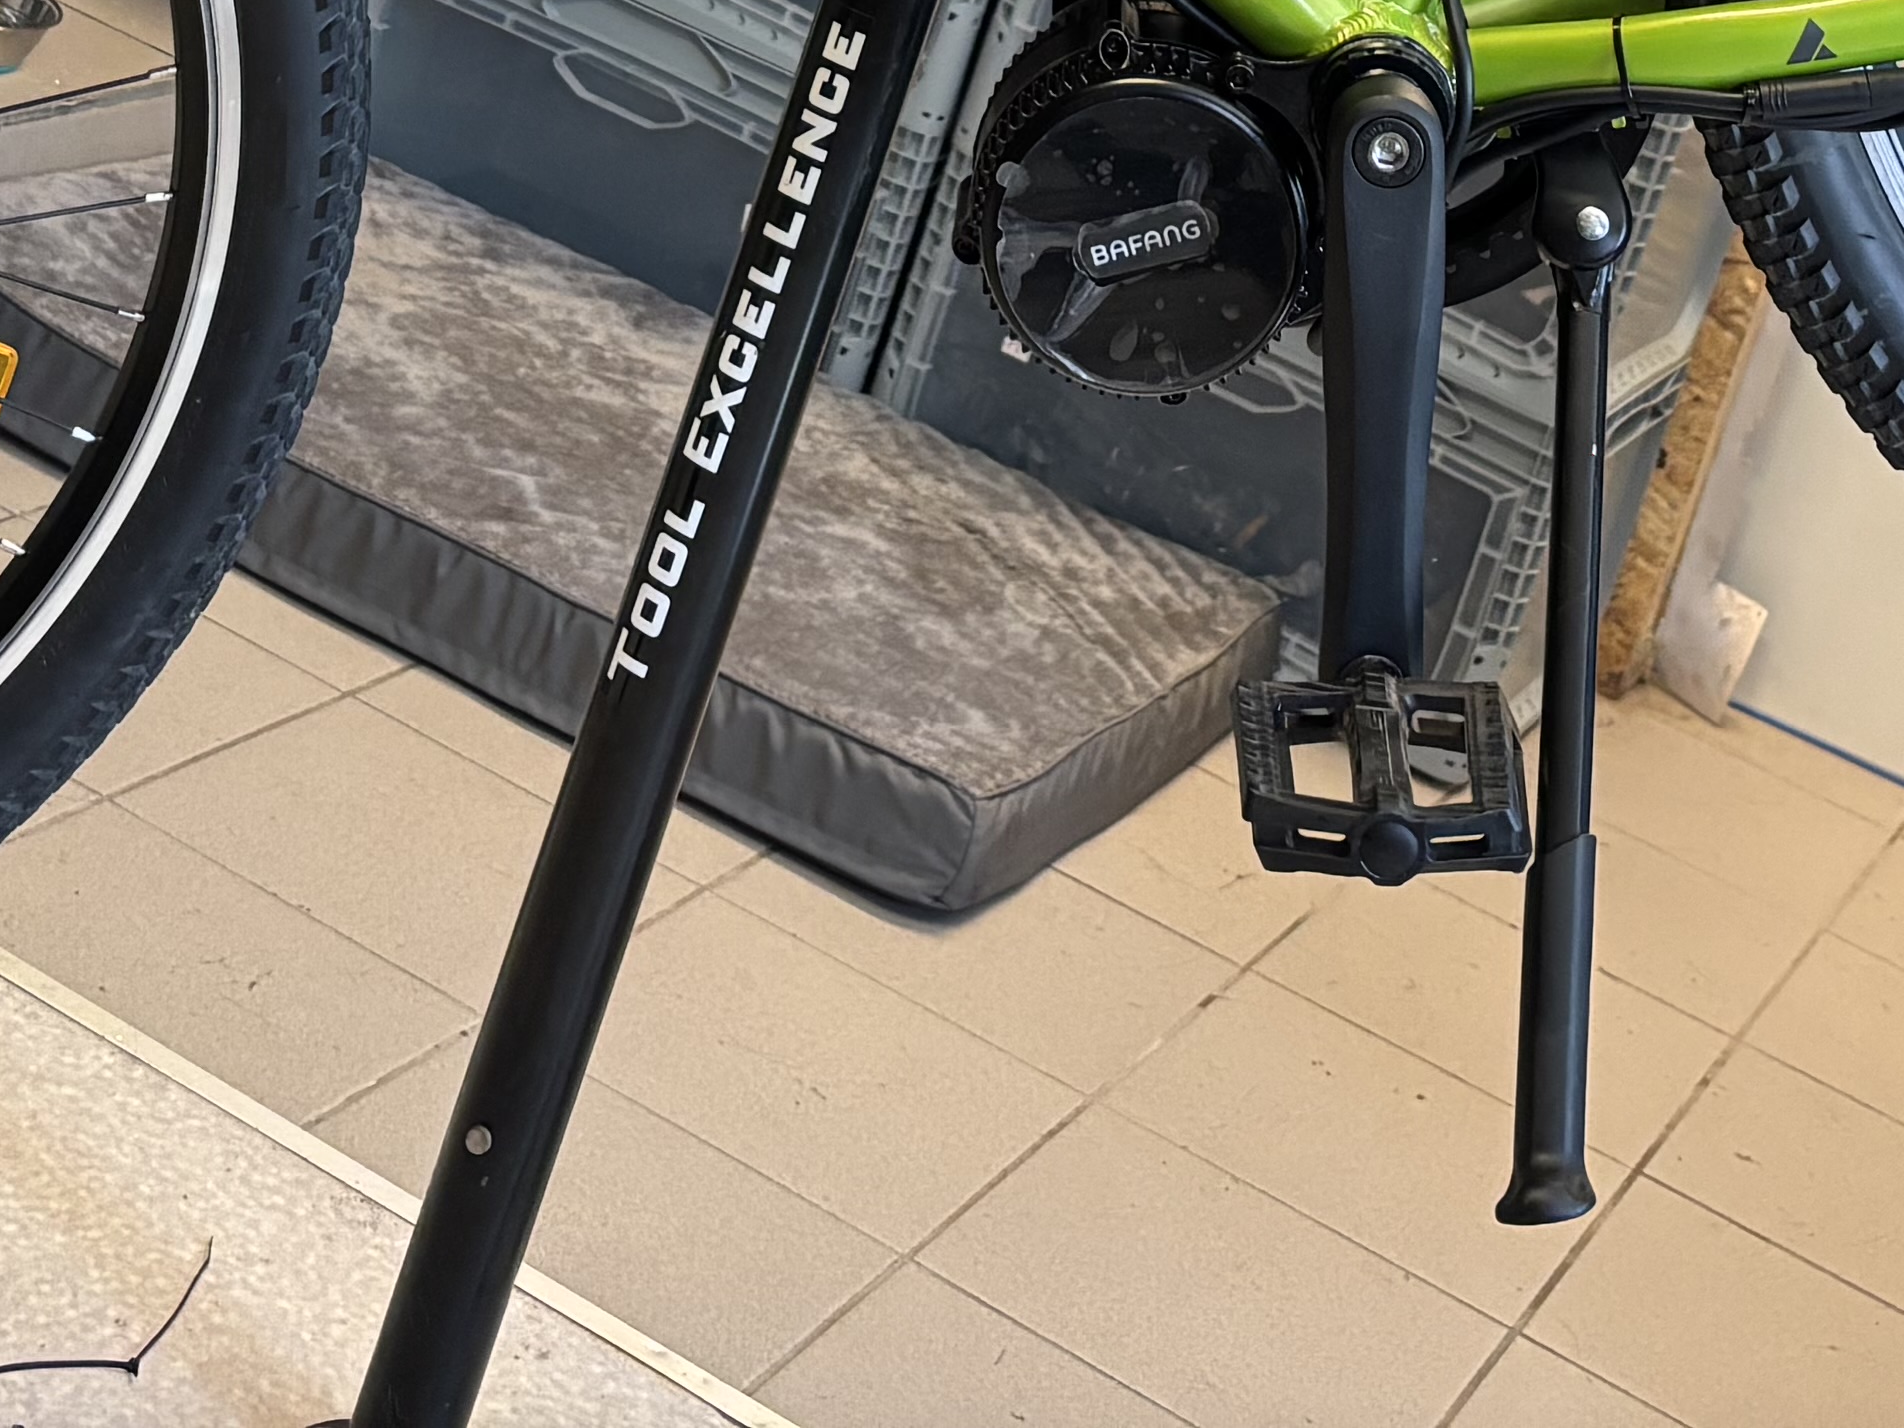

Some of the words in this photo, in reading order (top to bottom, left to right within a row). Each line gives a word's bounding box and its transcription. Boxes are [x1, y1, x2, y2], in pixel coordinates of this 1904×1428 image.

[606, 498, 707, 682] TOOL
[682, 19, 867, 475] EXCELLENCE
[1089, 216, 1202, 268] BAFANG
